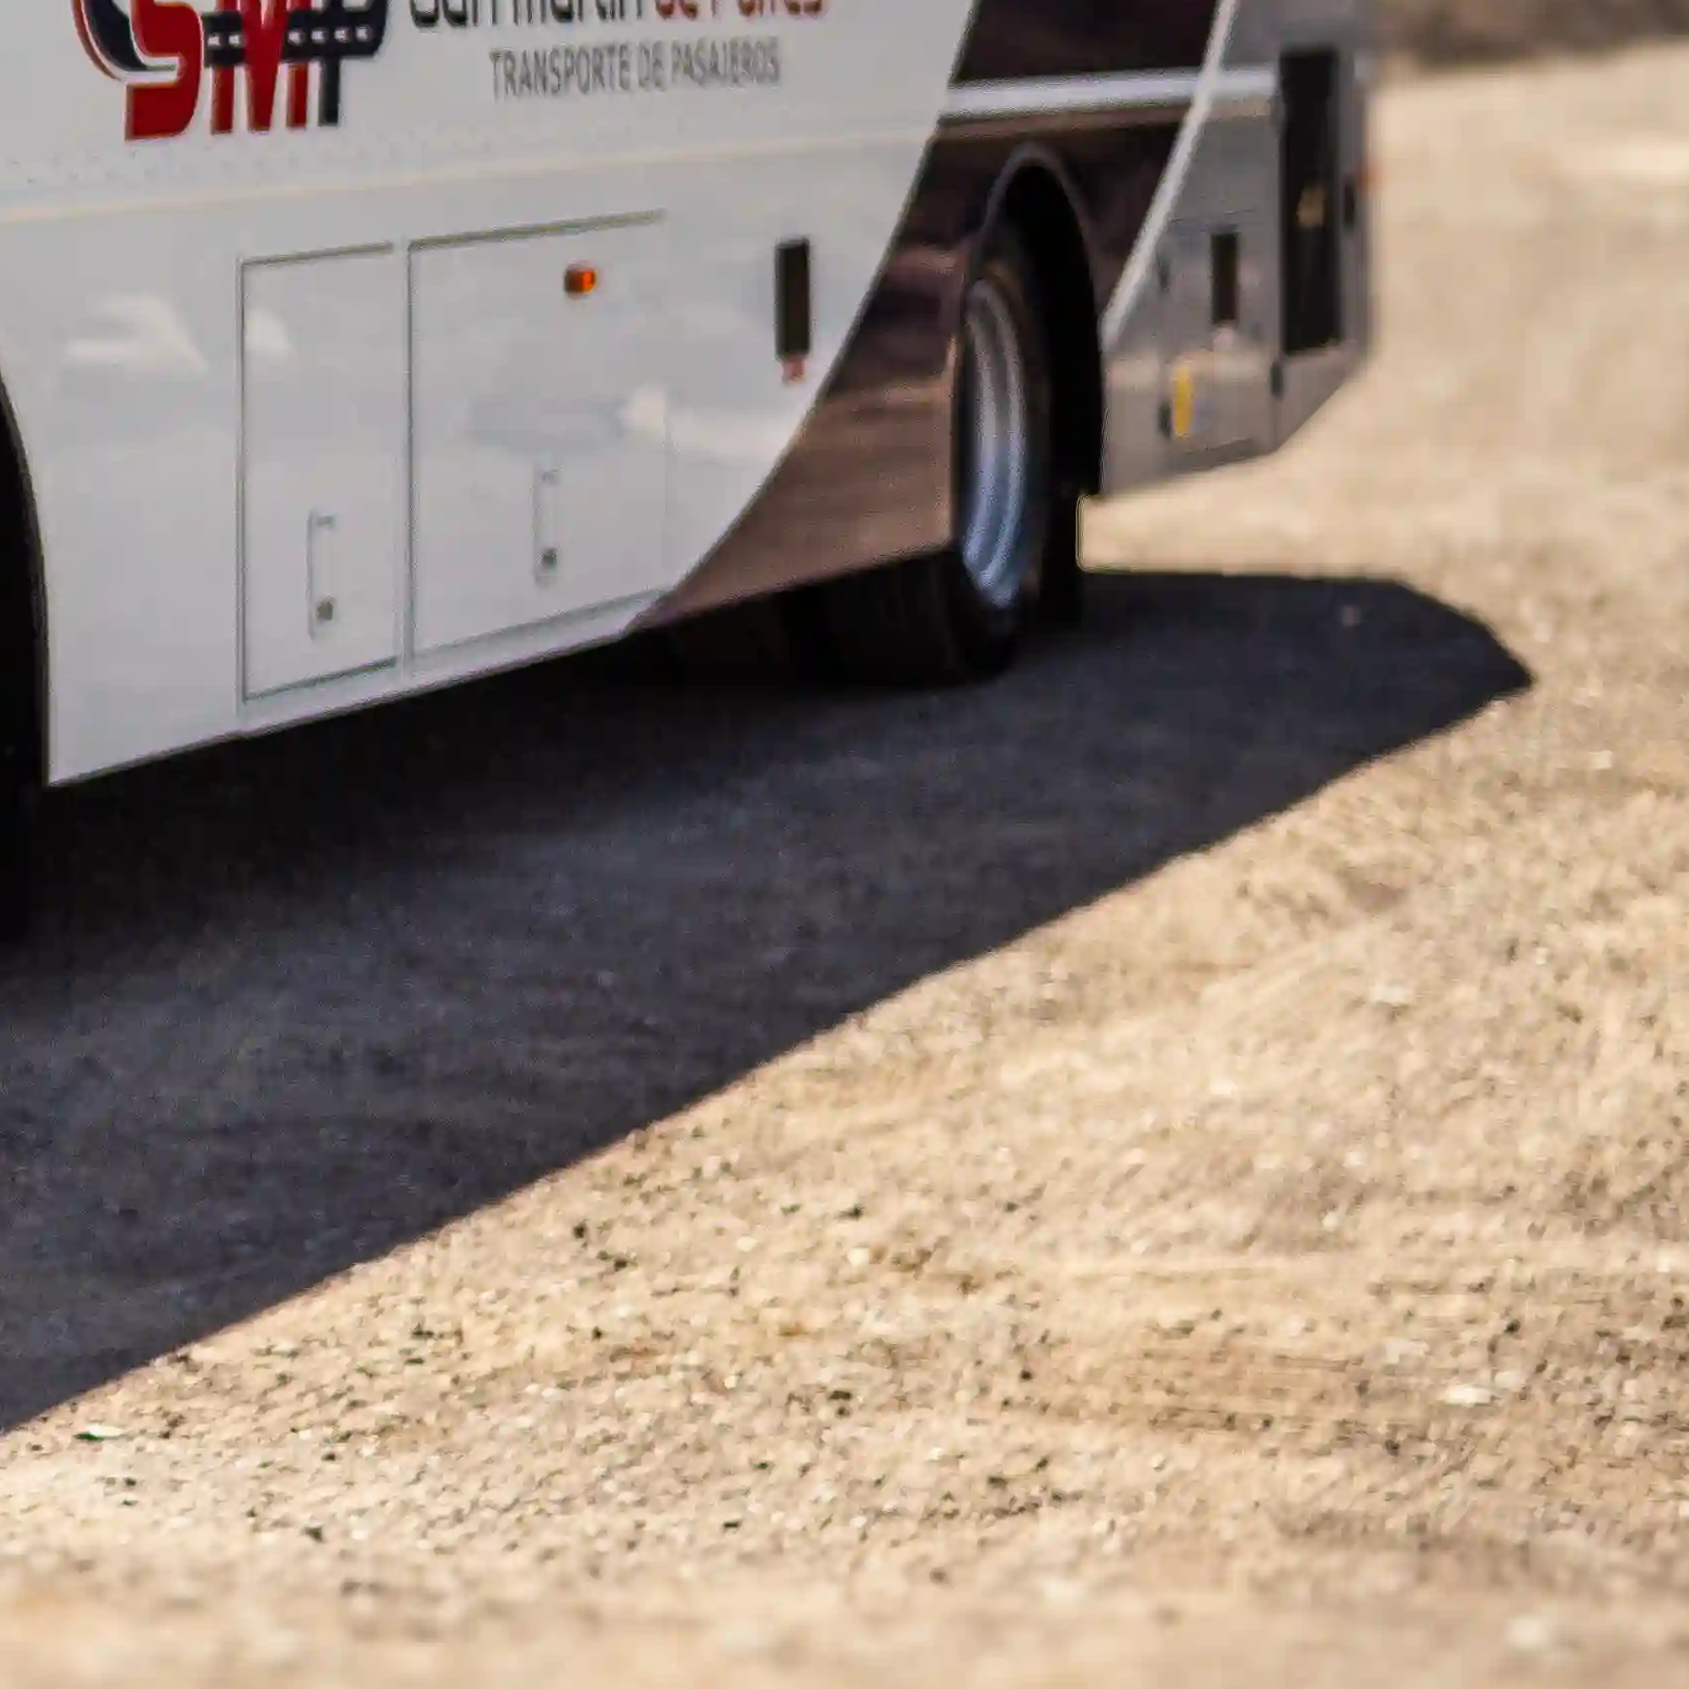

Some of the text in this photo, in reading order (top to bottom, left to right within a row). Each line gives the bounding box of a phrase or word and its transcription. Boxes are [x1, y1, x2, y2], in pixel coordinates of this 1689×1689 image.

[489, 37, 783, 102] TRANSPORTE DE PASAJEROS
